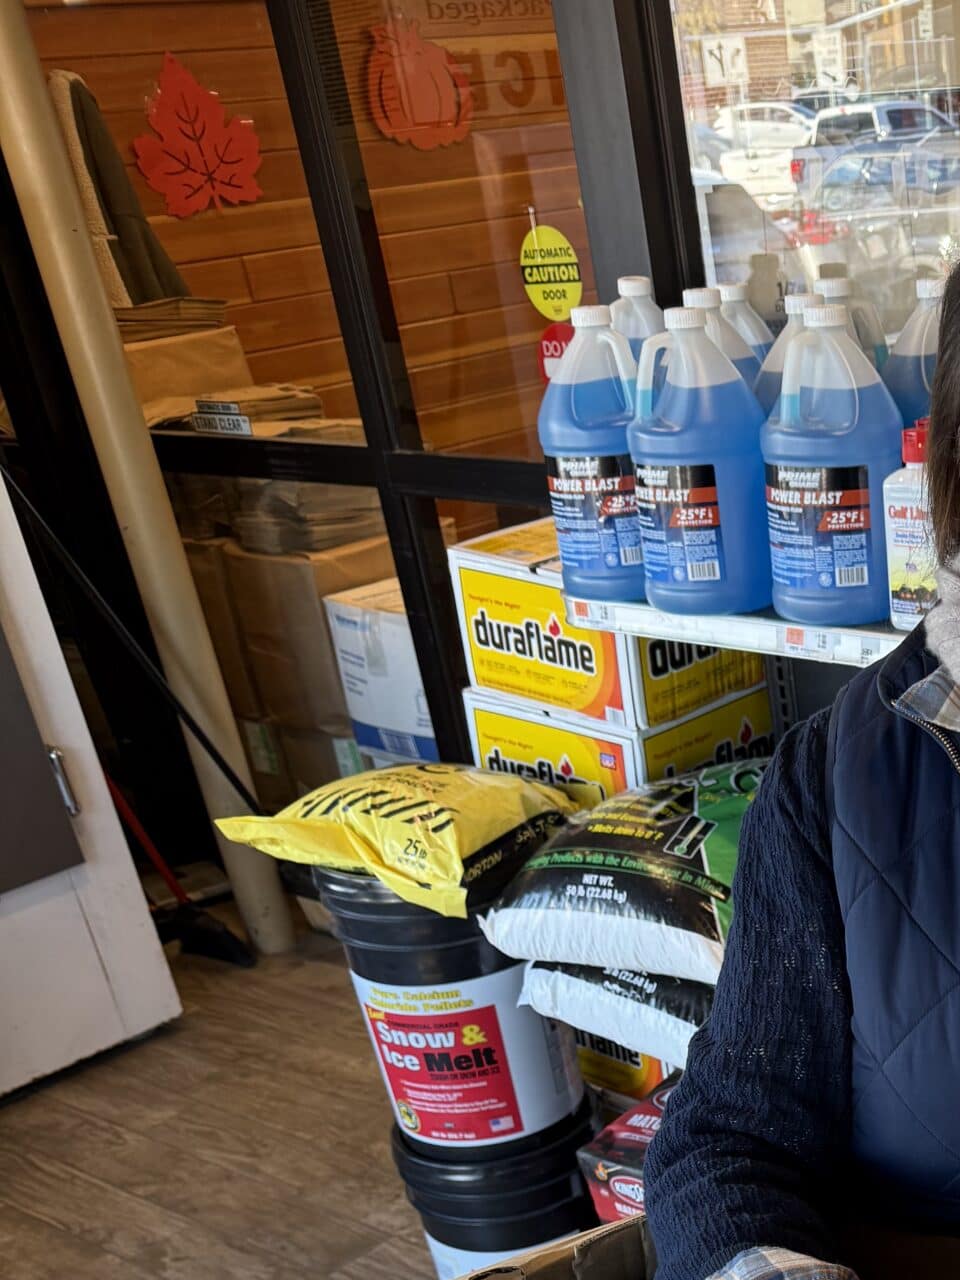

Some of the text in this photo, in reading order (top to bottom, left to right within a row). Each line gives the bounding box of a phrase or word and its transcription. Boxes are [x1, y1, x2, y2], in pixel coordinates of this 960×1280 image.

[523, 246, 573, 260] AUTOMATIC
[524, 264, 579, 283] CAUTION
[542, 288, 568, 301] DOOR
[553, 477, 621, 492] POWER BLAST
[655, 488, 690, 503] BLAST
[770, 490, 842, 505] POWER BLAST
[473, 610, 596, 675] duraflame
[404, 838, 421, 857] 25
[582, 873, 600, 886] NET
[375, 1020, 488, 1049] Snow &
[381, 1044, 499, 1073] Ice Melt
